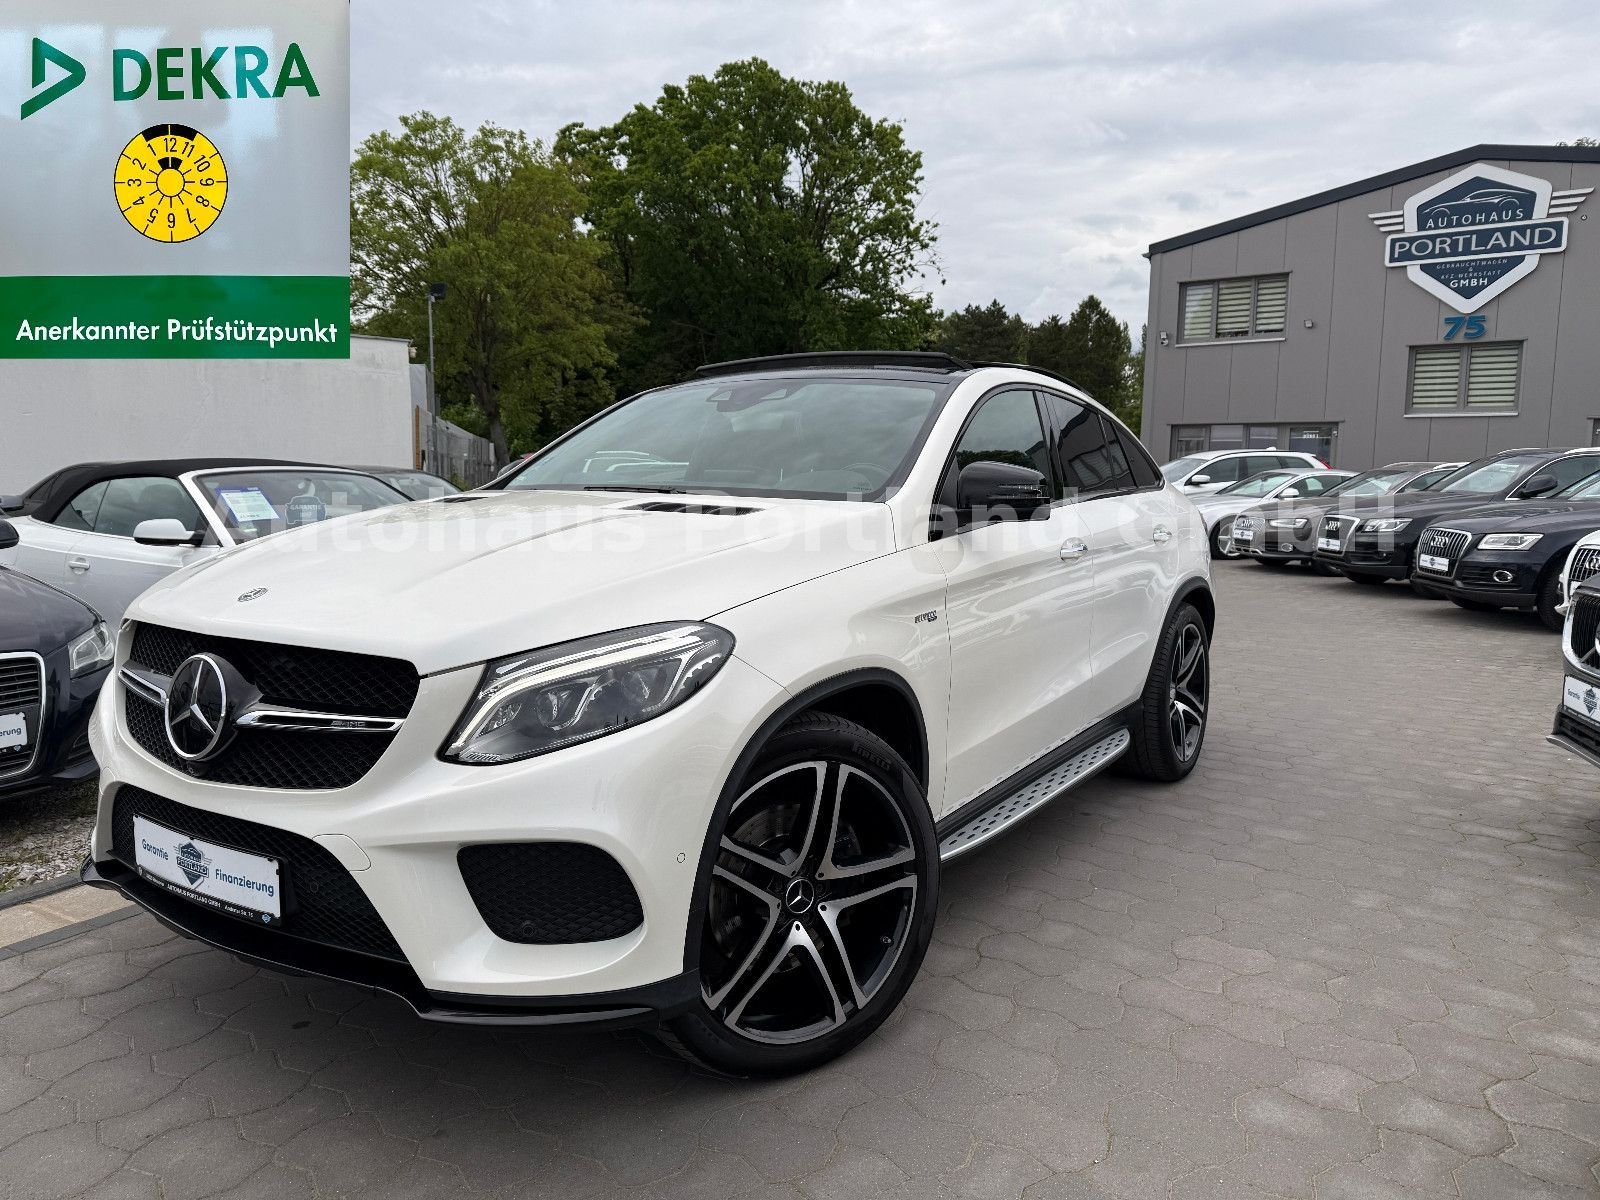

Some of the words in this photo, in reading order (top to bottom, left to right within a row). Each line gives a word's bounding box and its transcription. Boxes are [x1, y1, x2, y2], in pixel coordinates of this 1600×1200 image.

[1425, 208, 1525, 229] AUTOHAUS
[1394, 227, 1557, 258] PORTLAND
[1437, 259, 1508, 269] GEBRAUCHTWAGEN
[1450, 278, 1488, 288] GMBH
[1443, 315, 1487, 341] 75
[142, 839, 168, 860] Garantie
[215, 868, 275, 897] Finanzierung
